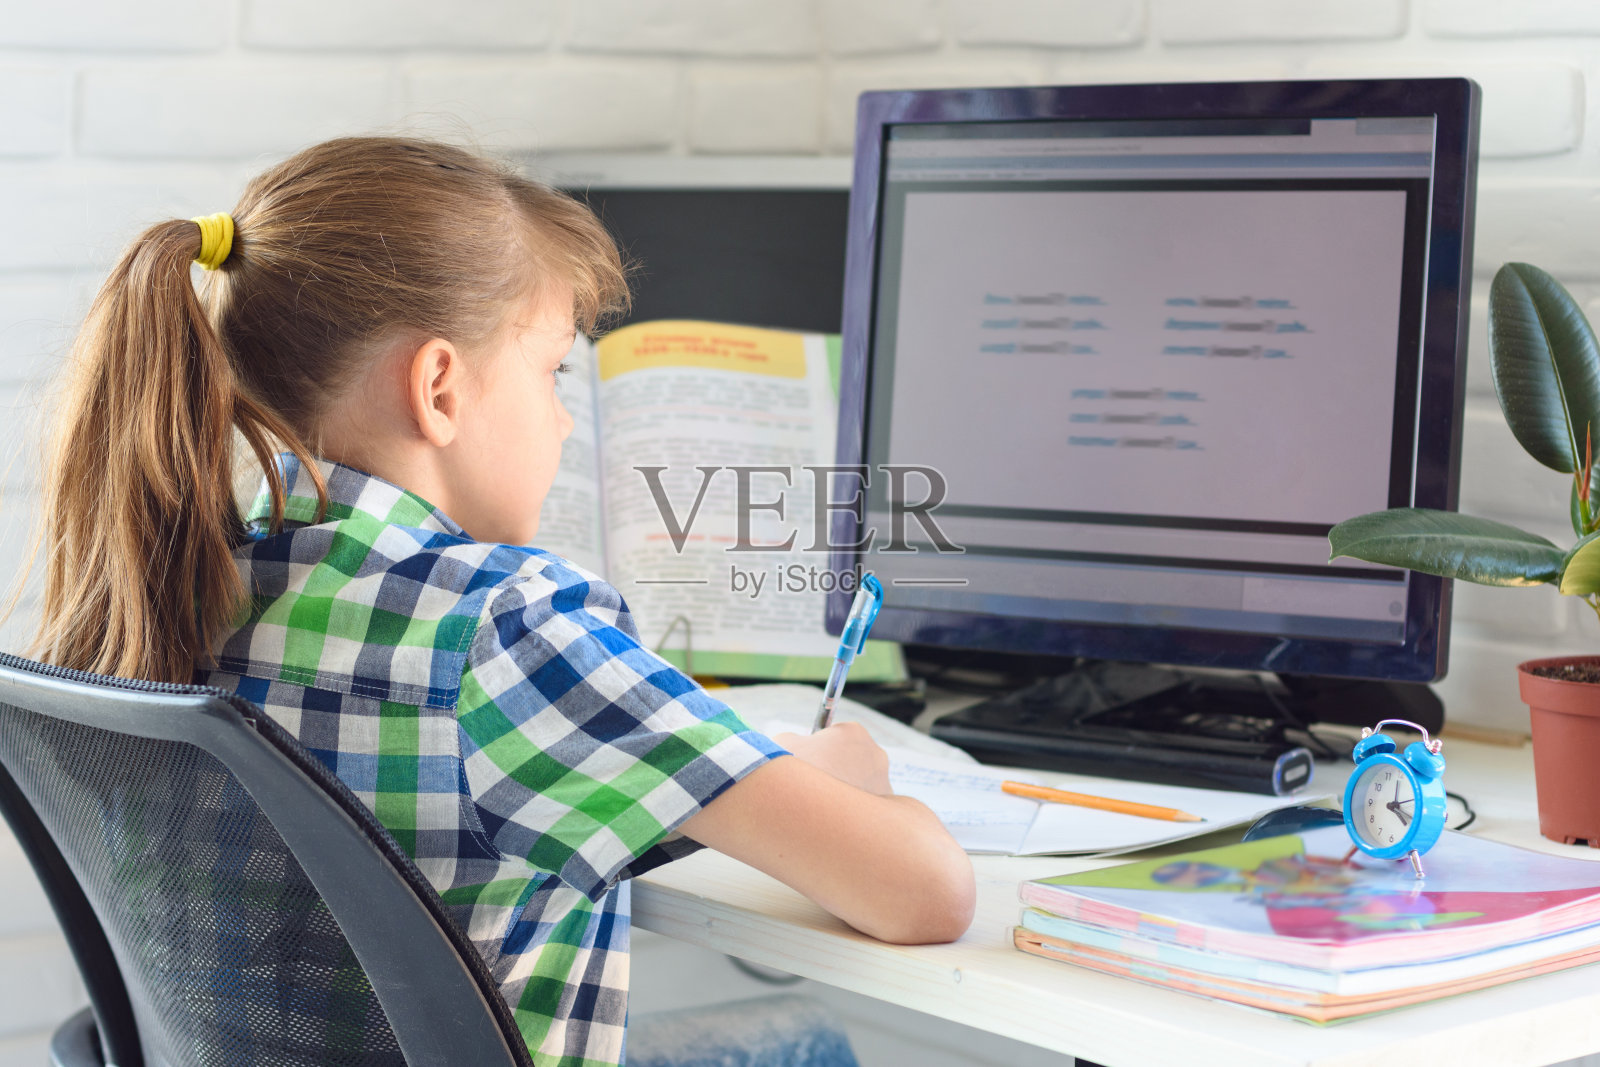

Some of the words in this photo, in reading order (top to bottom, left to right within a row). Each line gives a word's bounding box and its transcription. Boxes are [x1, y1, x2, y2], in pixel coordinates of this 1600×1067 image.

[1385, 772, 1392, 781] 11
[1374, 782, 1382, 792] 10
[1368, 798, 1373, 807] 9
[1369, 815, 1375, 823] 8
[1378, 827, 1383, 836] 7
[1389, 834, 1394, 843] 6
